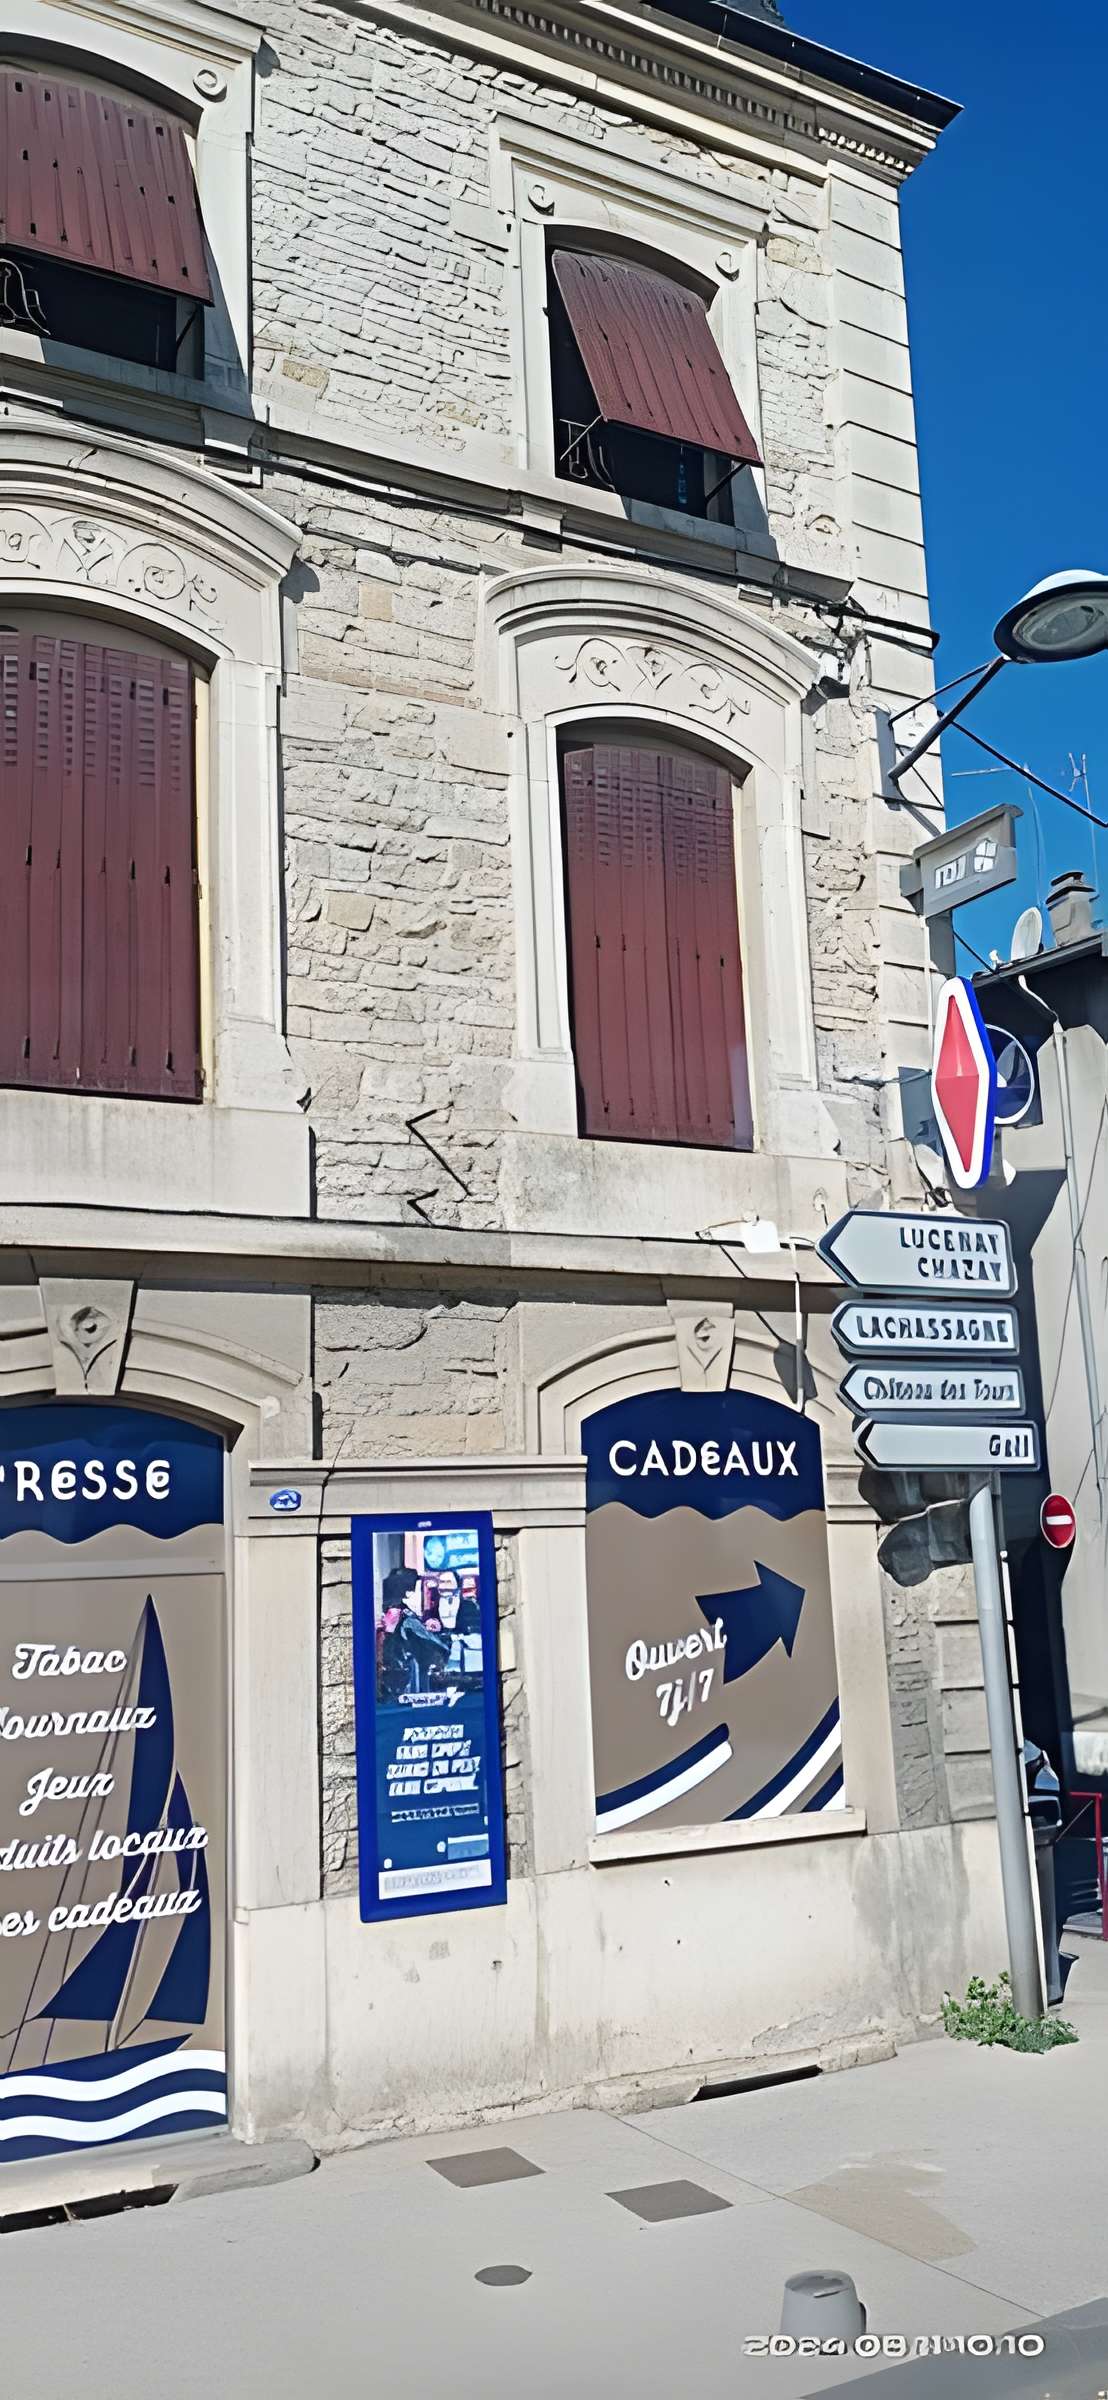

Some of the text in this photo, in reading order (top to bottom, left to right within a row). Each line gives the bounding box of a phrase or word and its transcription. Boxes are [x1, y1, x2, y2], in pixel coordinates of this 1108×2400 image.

[0, 1459, 171, 1502] RESSE
[608, 1439, 800, 1477] CADEAUX
[11, 1643, 128, 1680] Tabac
[625, 1616, 728, 1681] Ouvert
[655, 1667, 715, 1728] 7j/7
[18, 1767, 115, 1816] Jeux
[87, 1826, 209, 1861] locaux
[0, 1889, 202, 1938] es cadeaux
